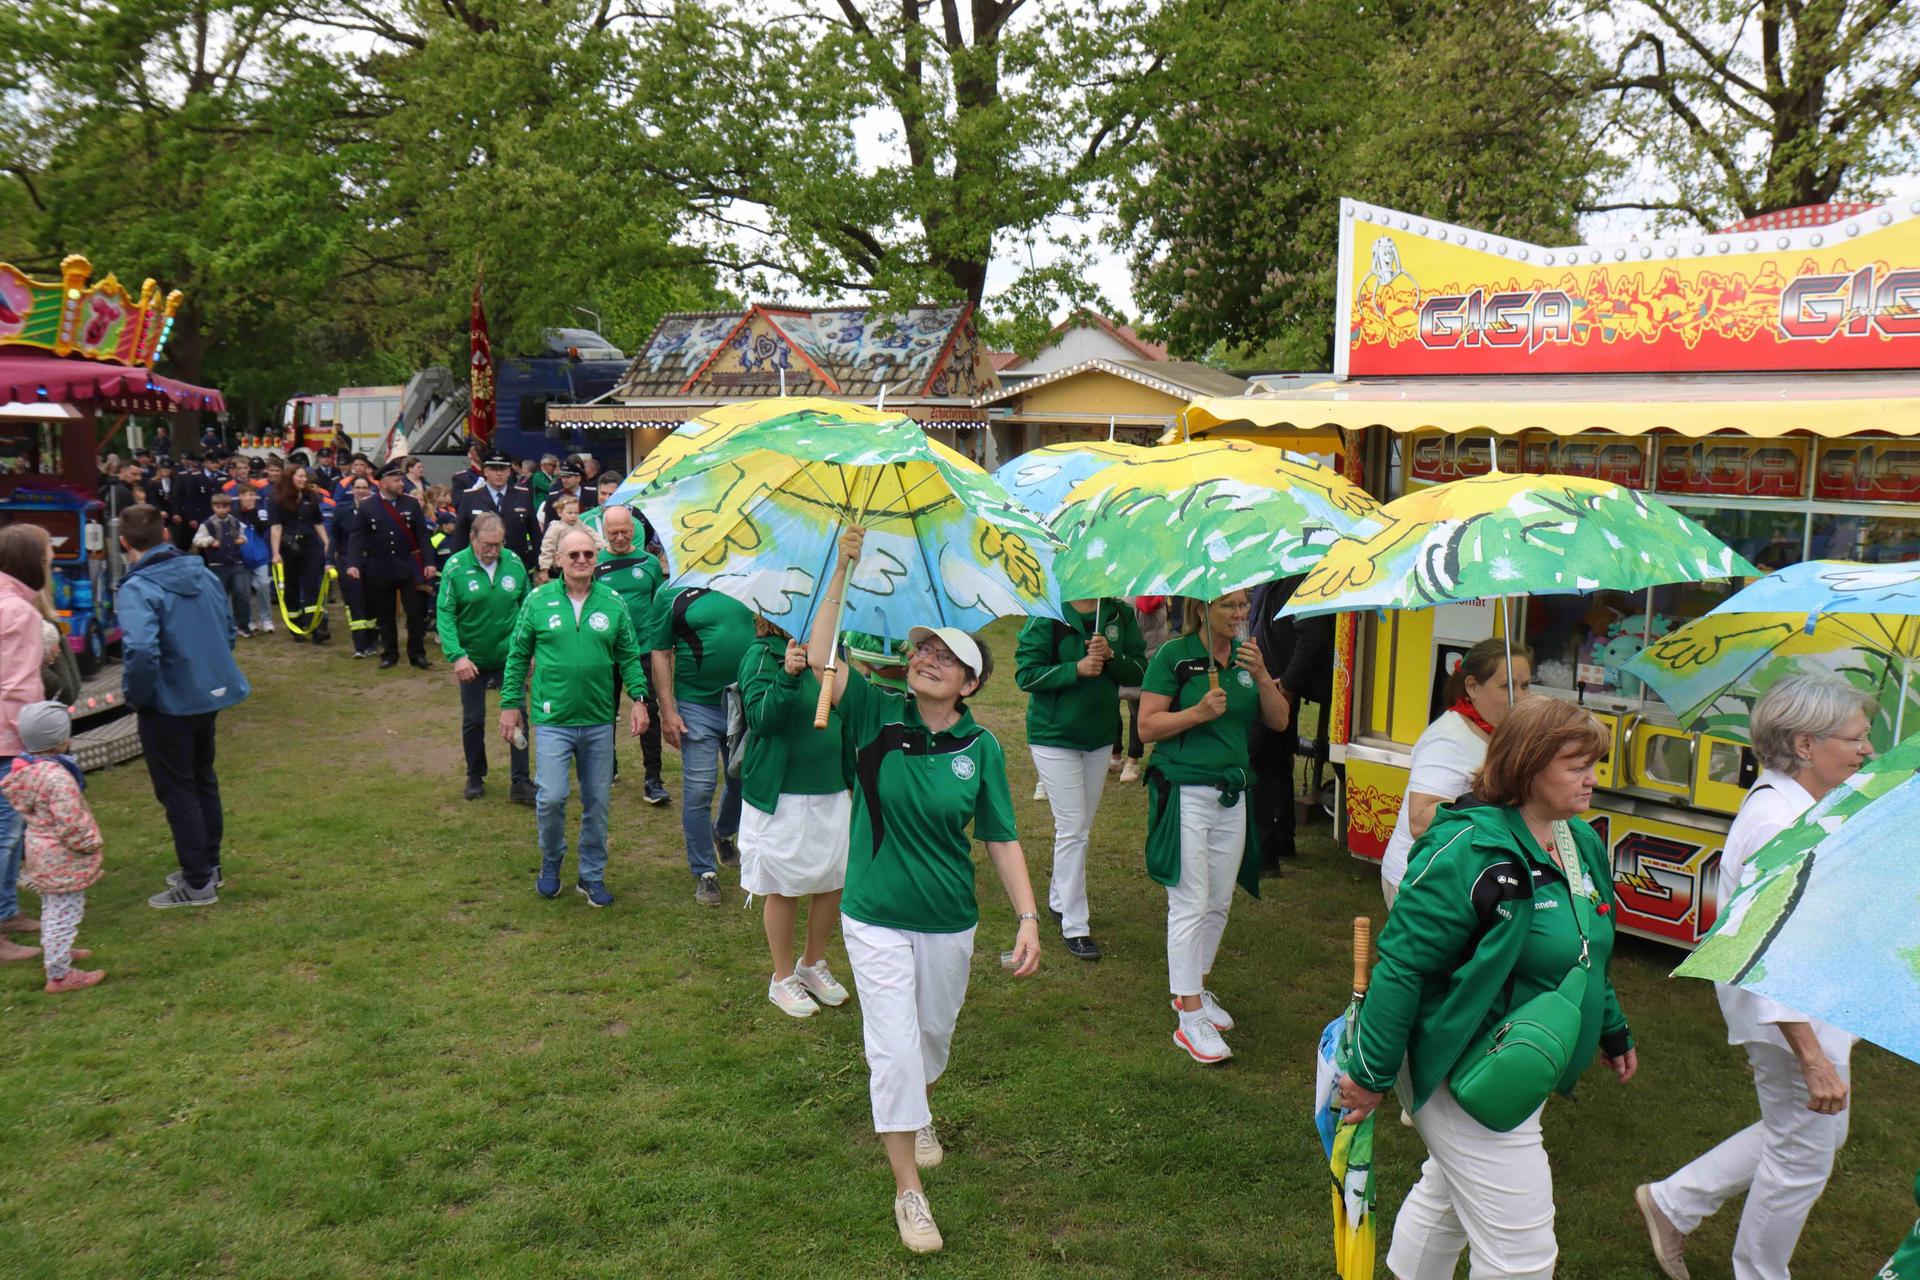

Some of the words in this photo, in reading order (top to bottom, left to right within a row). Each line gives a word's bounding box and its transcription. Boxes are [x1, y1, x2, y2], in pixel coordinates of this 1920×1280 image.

[1419, 287, 1573, 354] GIGA
[1779, 264, 1920, 340] GIG
[1661, 441, 1799, 492] GIGA
